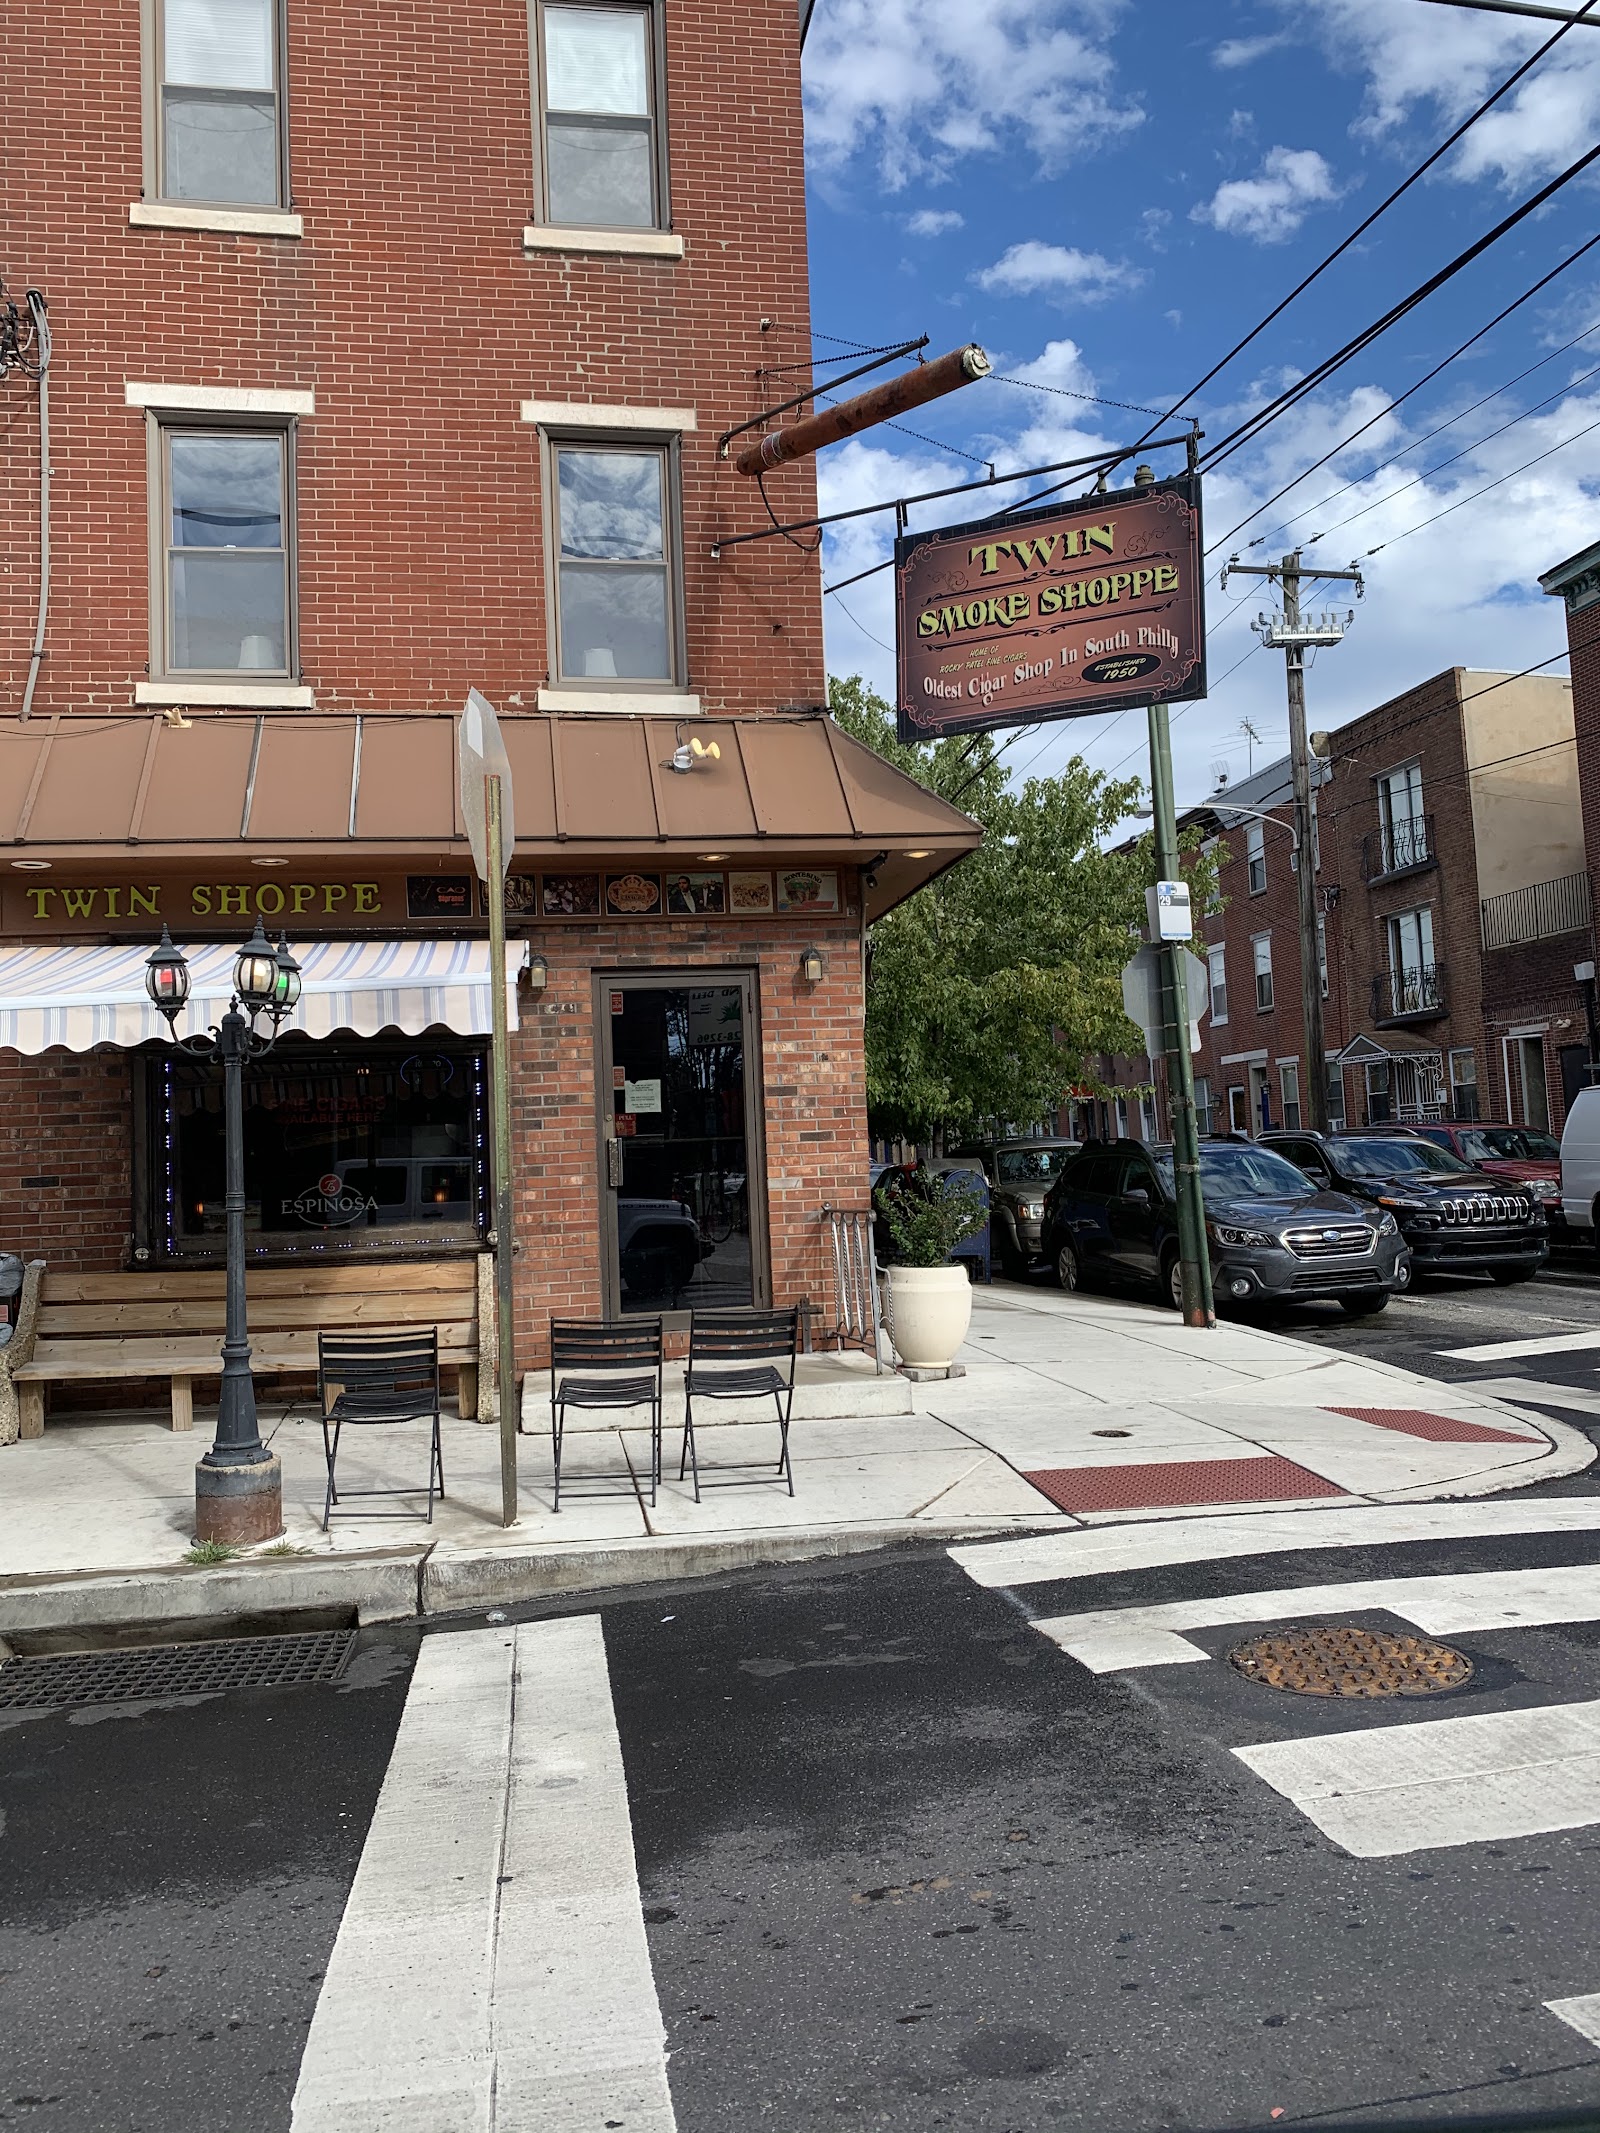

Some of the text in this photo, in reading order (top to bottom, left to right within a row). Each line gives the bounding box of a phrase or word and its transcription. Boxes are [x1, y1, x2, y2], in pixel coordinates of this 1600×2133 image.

[969, 521, 1117, 576] TWIN
[917, 563, 1180, 639] SMOKE SHOPPE
[969, 645, 1000, 658] HOME OF
[923, 624, 1180, 707] Oldest Cigar Shop In South Philly
[939, 651, 1028, 674] ROCKY PATEL FINE CIGARS
[1094, 657, 1147, 672] ESTABLISHED
[1103, 666, 1139, 681] 1950
[782, 871, 823, 884] MONTESINO
[436, 886, 466, 894] CAO
[26, 882, 383, 920] TWIN SHOPPE
[1159, 895, 1171, 906] 29
[280, 1195, 380, 1215] ESPINOSA
